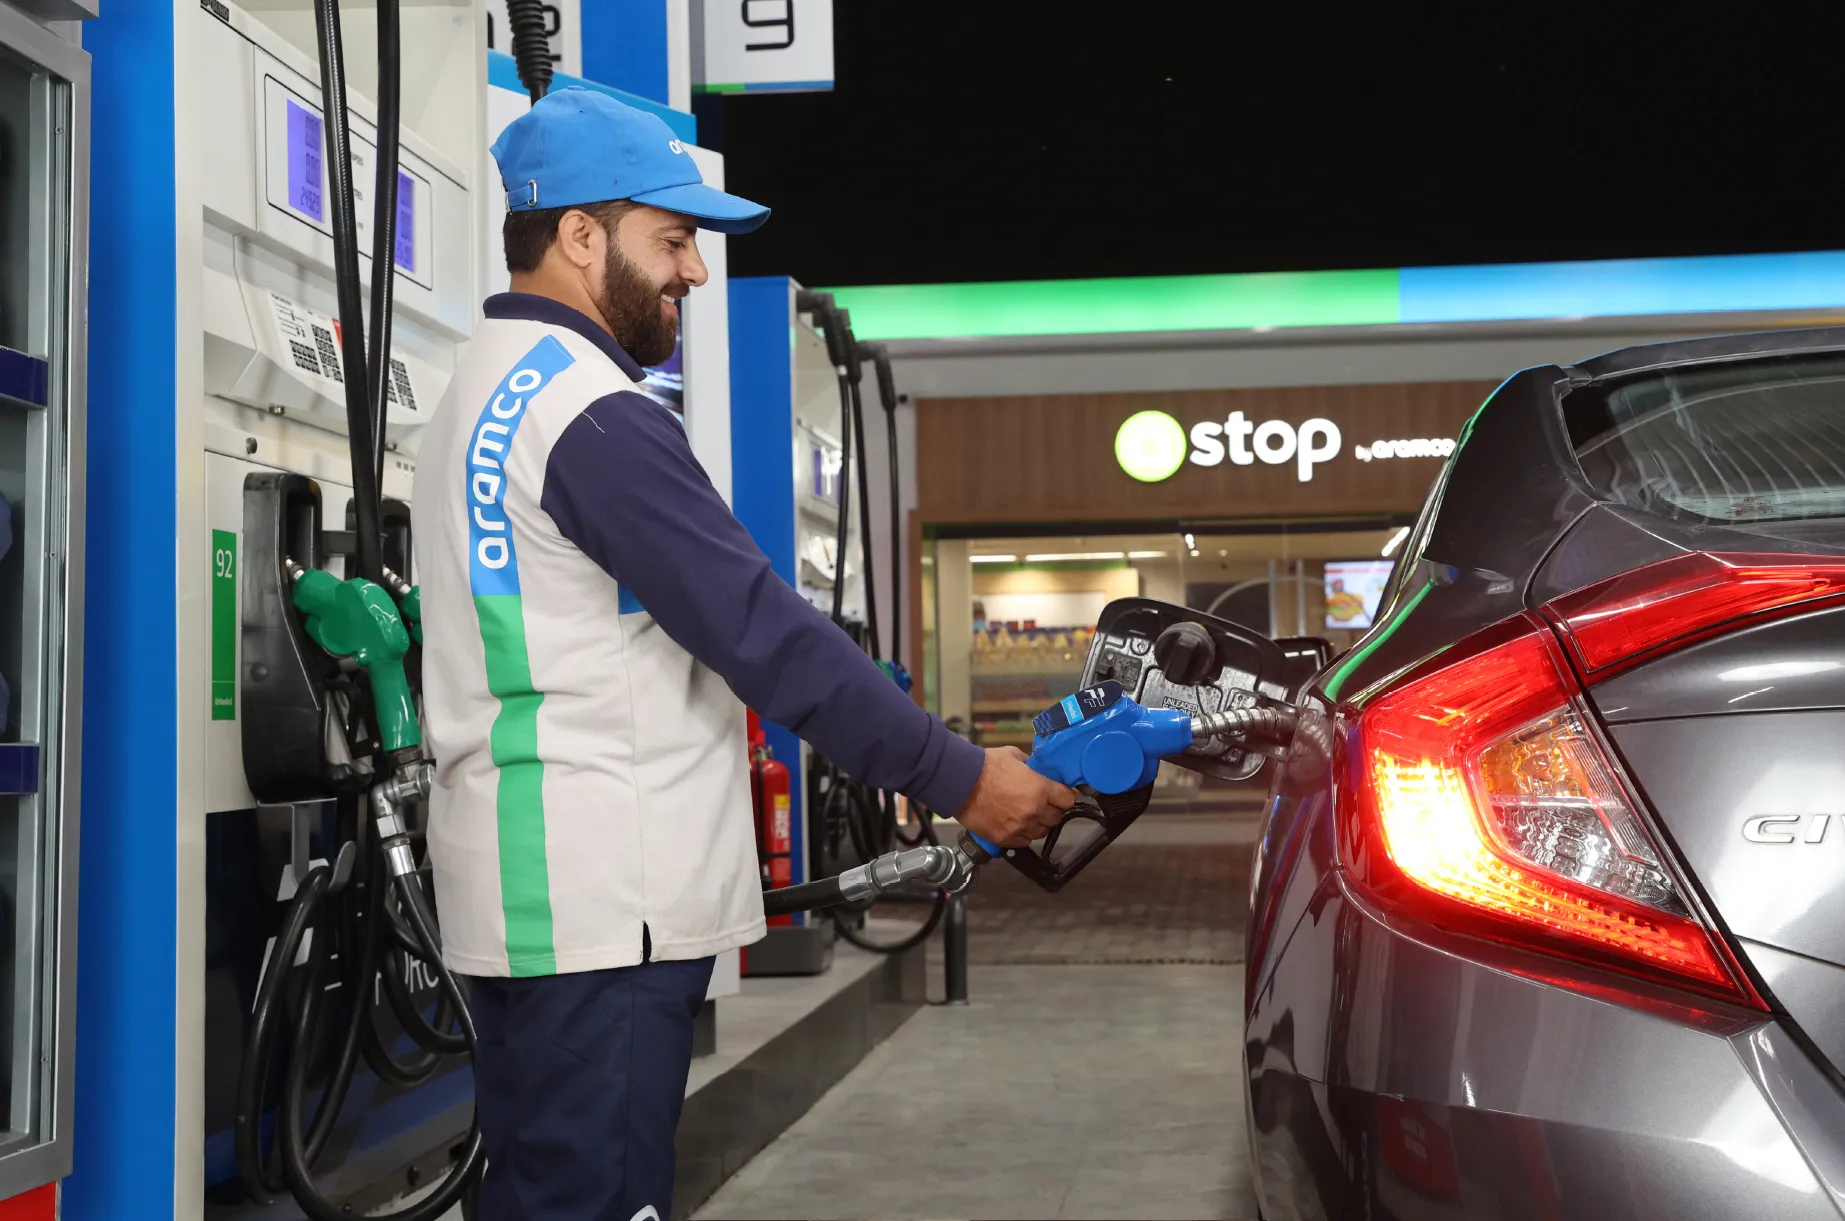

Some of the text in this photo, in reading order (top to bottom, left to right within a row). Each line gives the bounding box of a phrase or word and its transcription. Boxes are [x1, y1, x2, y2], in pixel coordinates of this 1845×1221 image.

[1189, 410, 1342, 482] stop
[1371, 438, 1456, 460] aramco
[472, 368, 542, 570] aramco
[216, 549, 233, 579] 92
[1163, 696, 1198, 712] UNLEADED
[1742, 813, 1845, 844] CI
